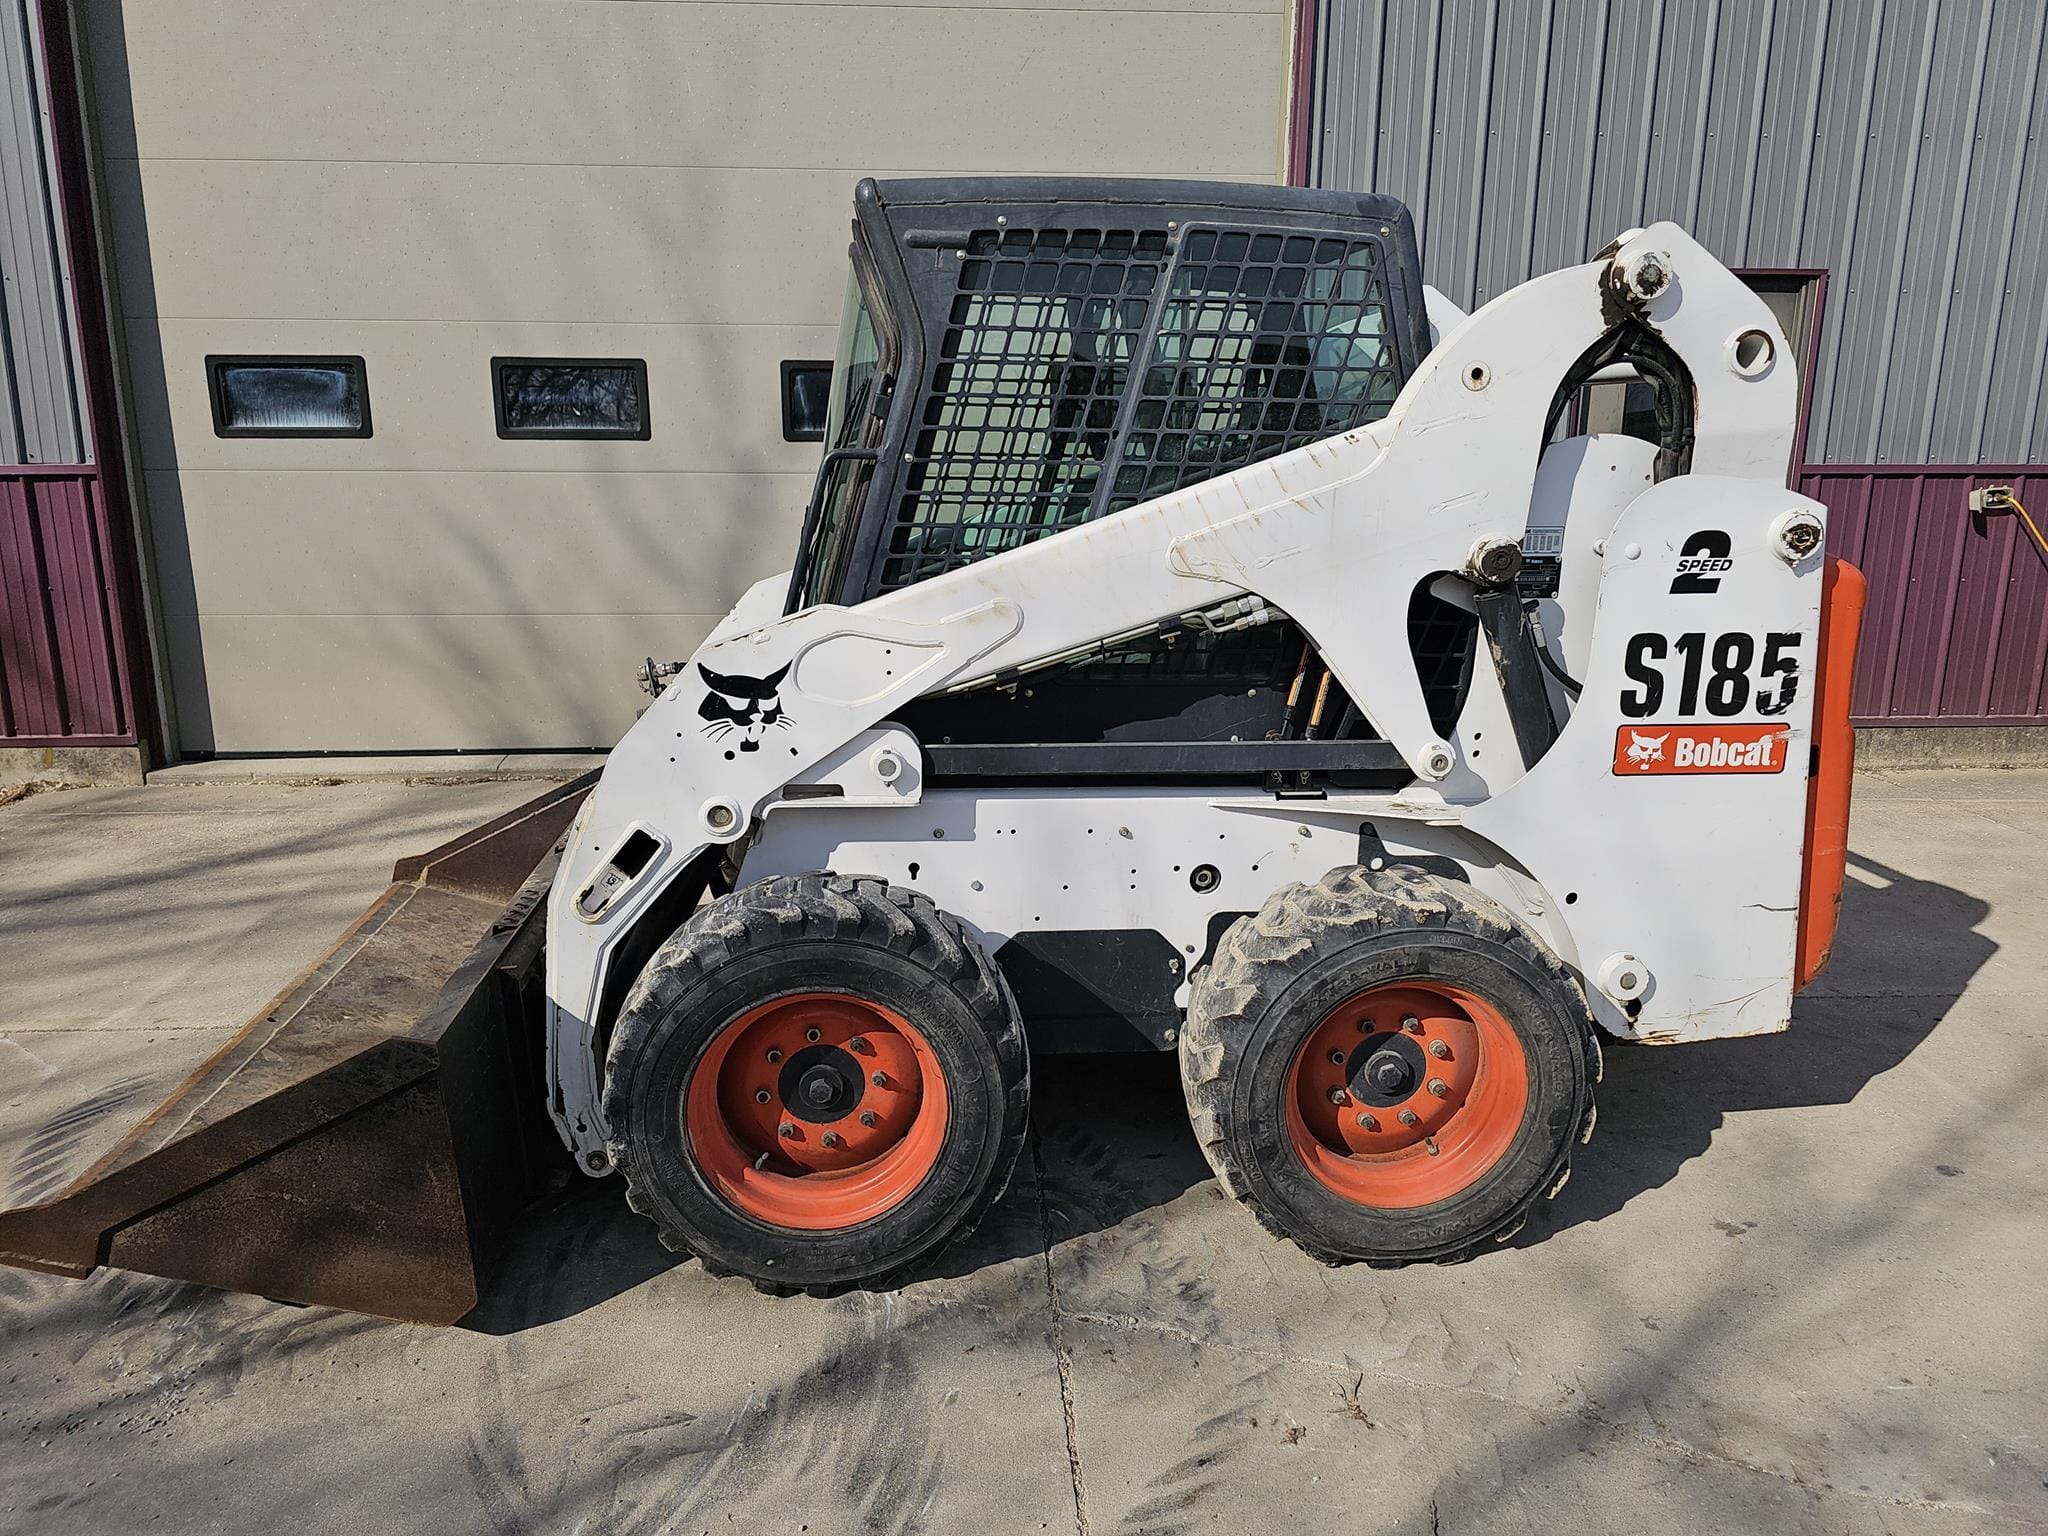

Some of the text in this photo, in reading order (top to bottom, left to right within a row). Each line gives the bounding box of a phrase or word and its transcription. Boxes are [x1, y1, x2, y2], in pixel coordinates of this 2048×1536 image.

[1669, 530, 1731, 594] 2
[1676, 559, 1733, 572] SPEED
[1620, 632, 1801, 718] S185
[1674, 736, 1773, 767] Bobcat
